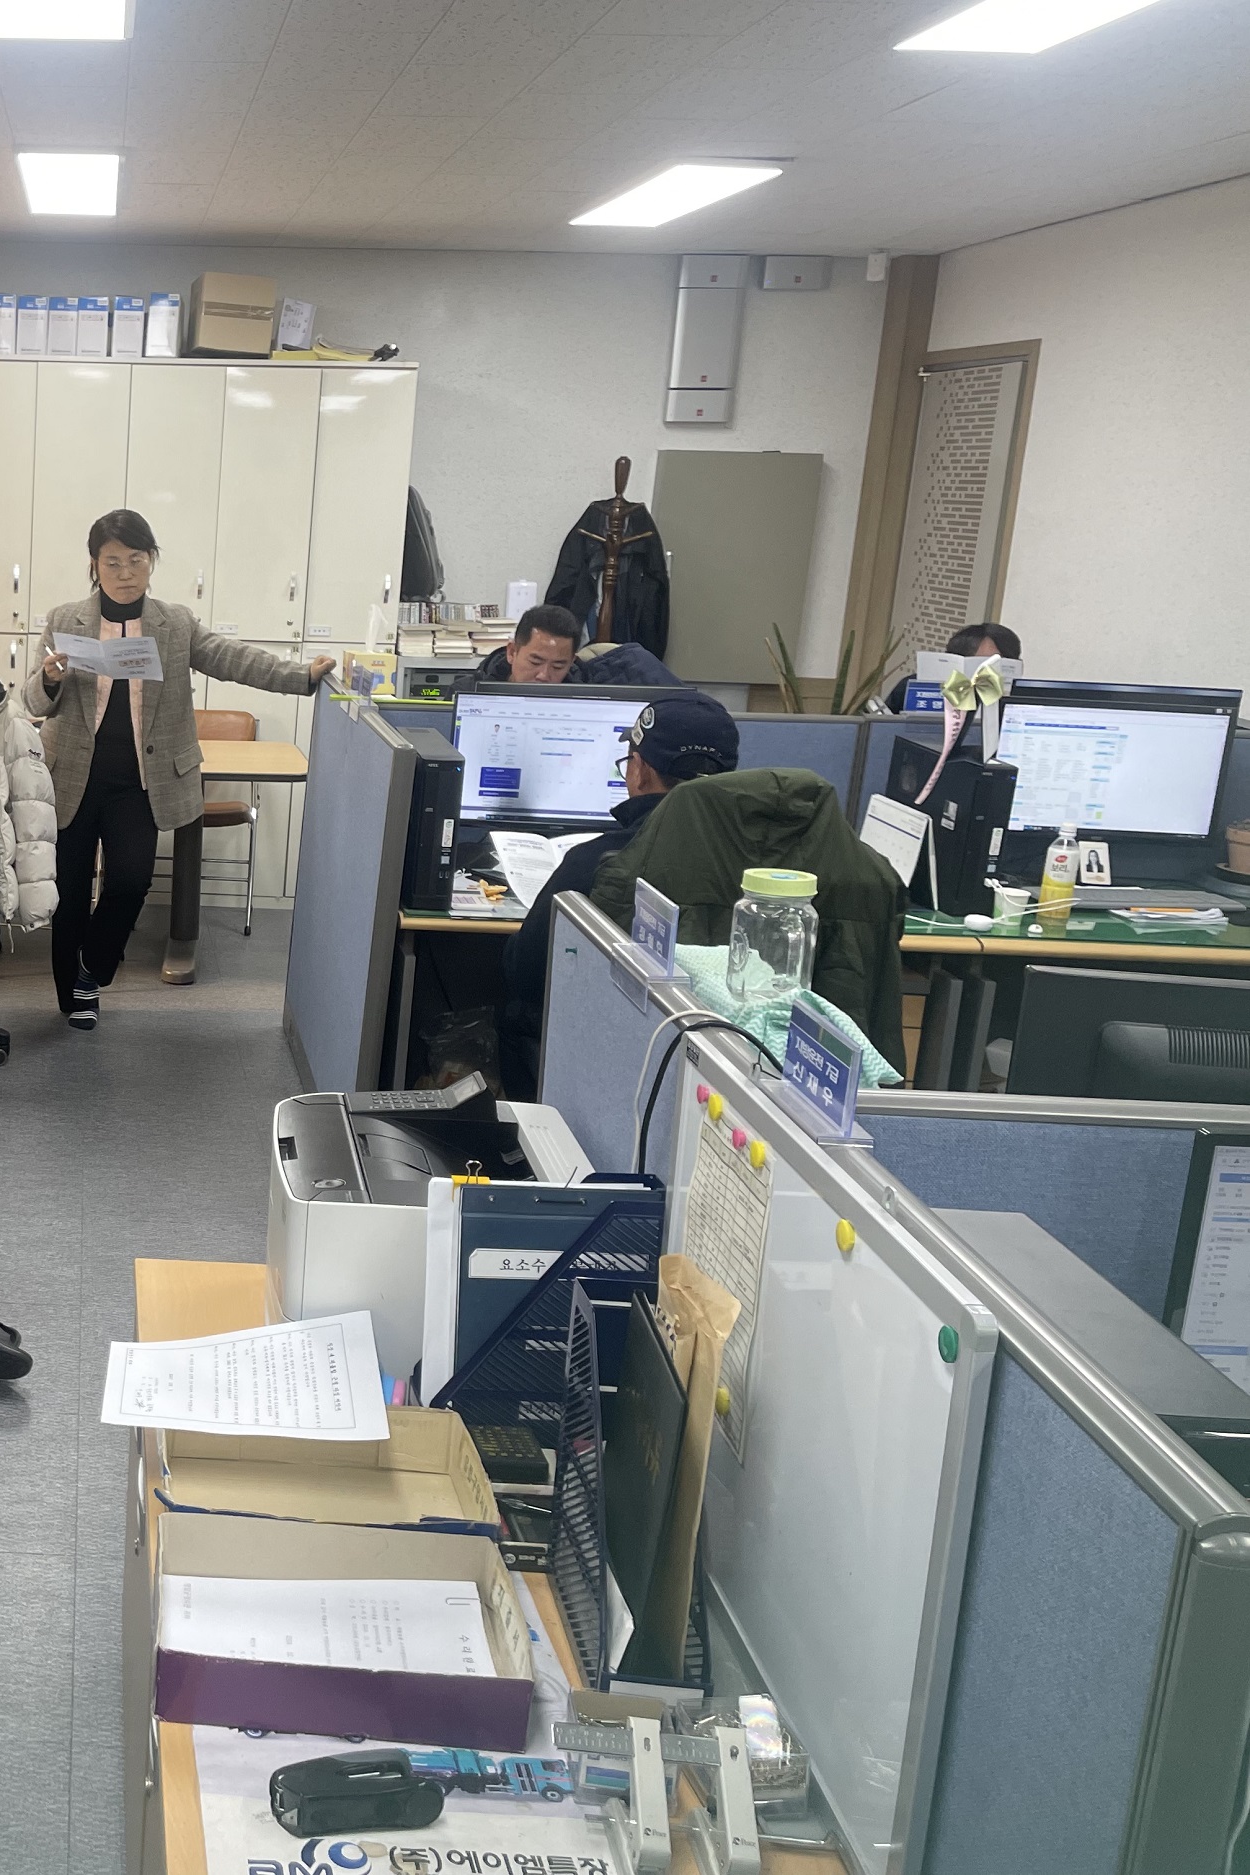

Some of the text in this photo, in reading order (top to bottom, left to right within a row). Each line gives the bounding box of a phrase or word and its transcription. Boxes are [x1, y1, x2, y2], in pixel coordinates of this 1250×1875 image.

[1051, 863, 1069, 873] 보리
[825, 1061, 839, 1084] 7급
[499, 1258, 547, 1274] 요소수
